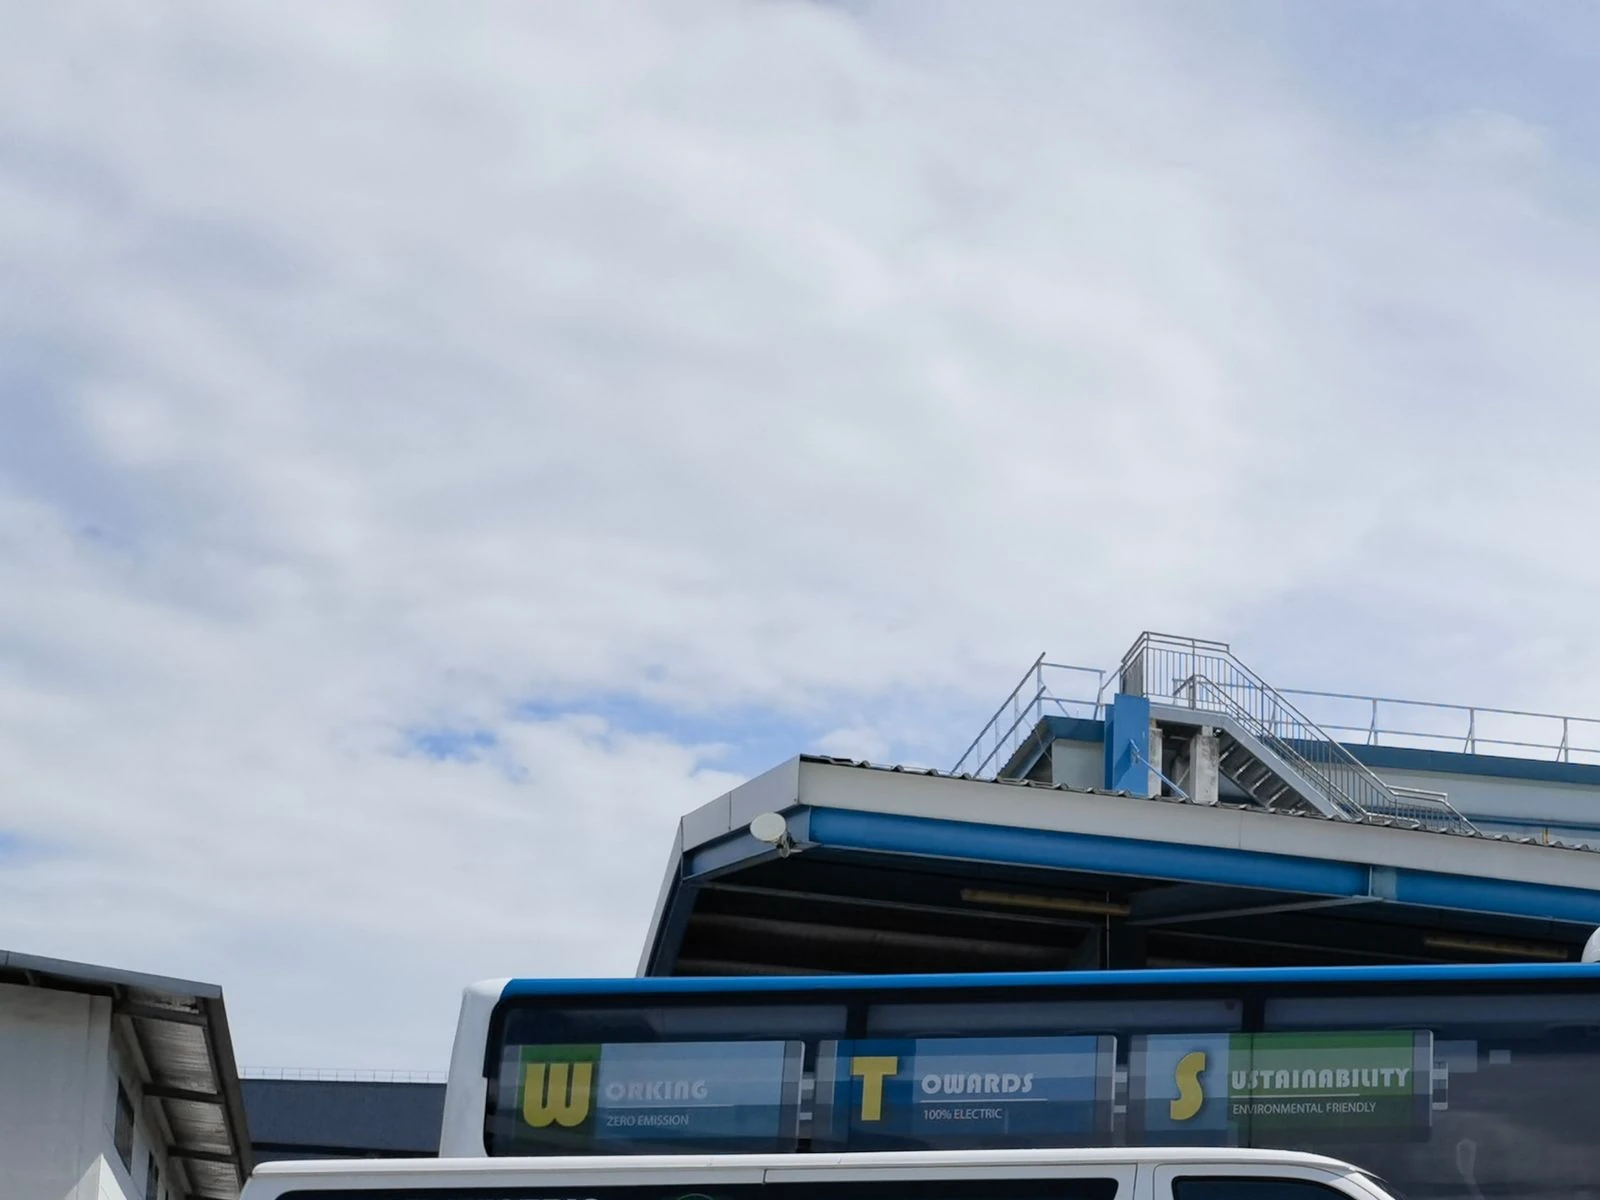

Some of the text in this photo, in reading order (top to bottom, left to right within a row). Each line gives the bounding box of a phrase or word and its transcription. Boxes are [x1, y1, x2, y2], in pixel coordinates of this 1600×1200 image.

[923, 1107, 1003, 1120] 100% ELECTRIC
[1232, 1101, 1376, 1115] ENVIRONMENTAL FRIENDLY
[606, 1114, 689, 1127] ZERO EMISSION
